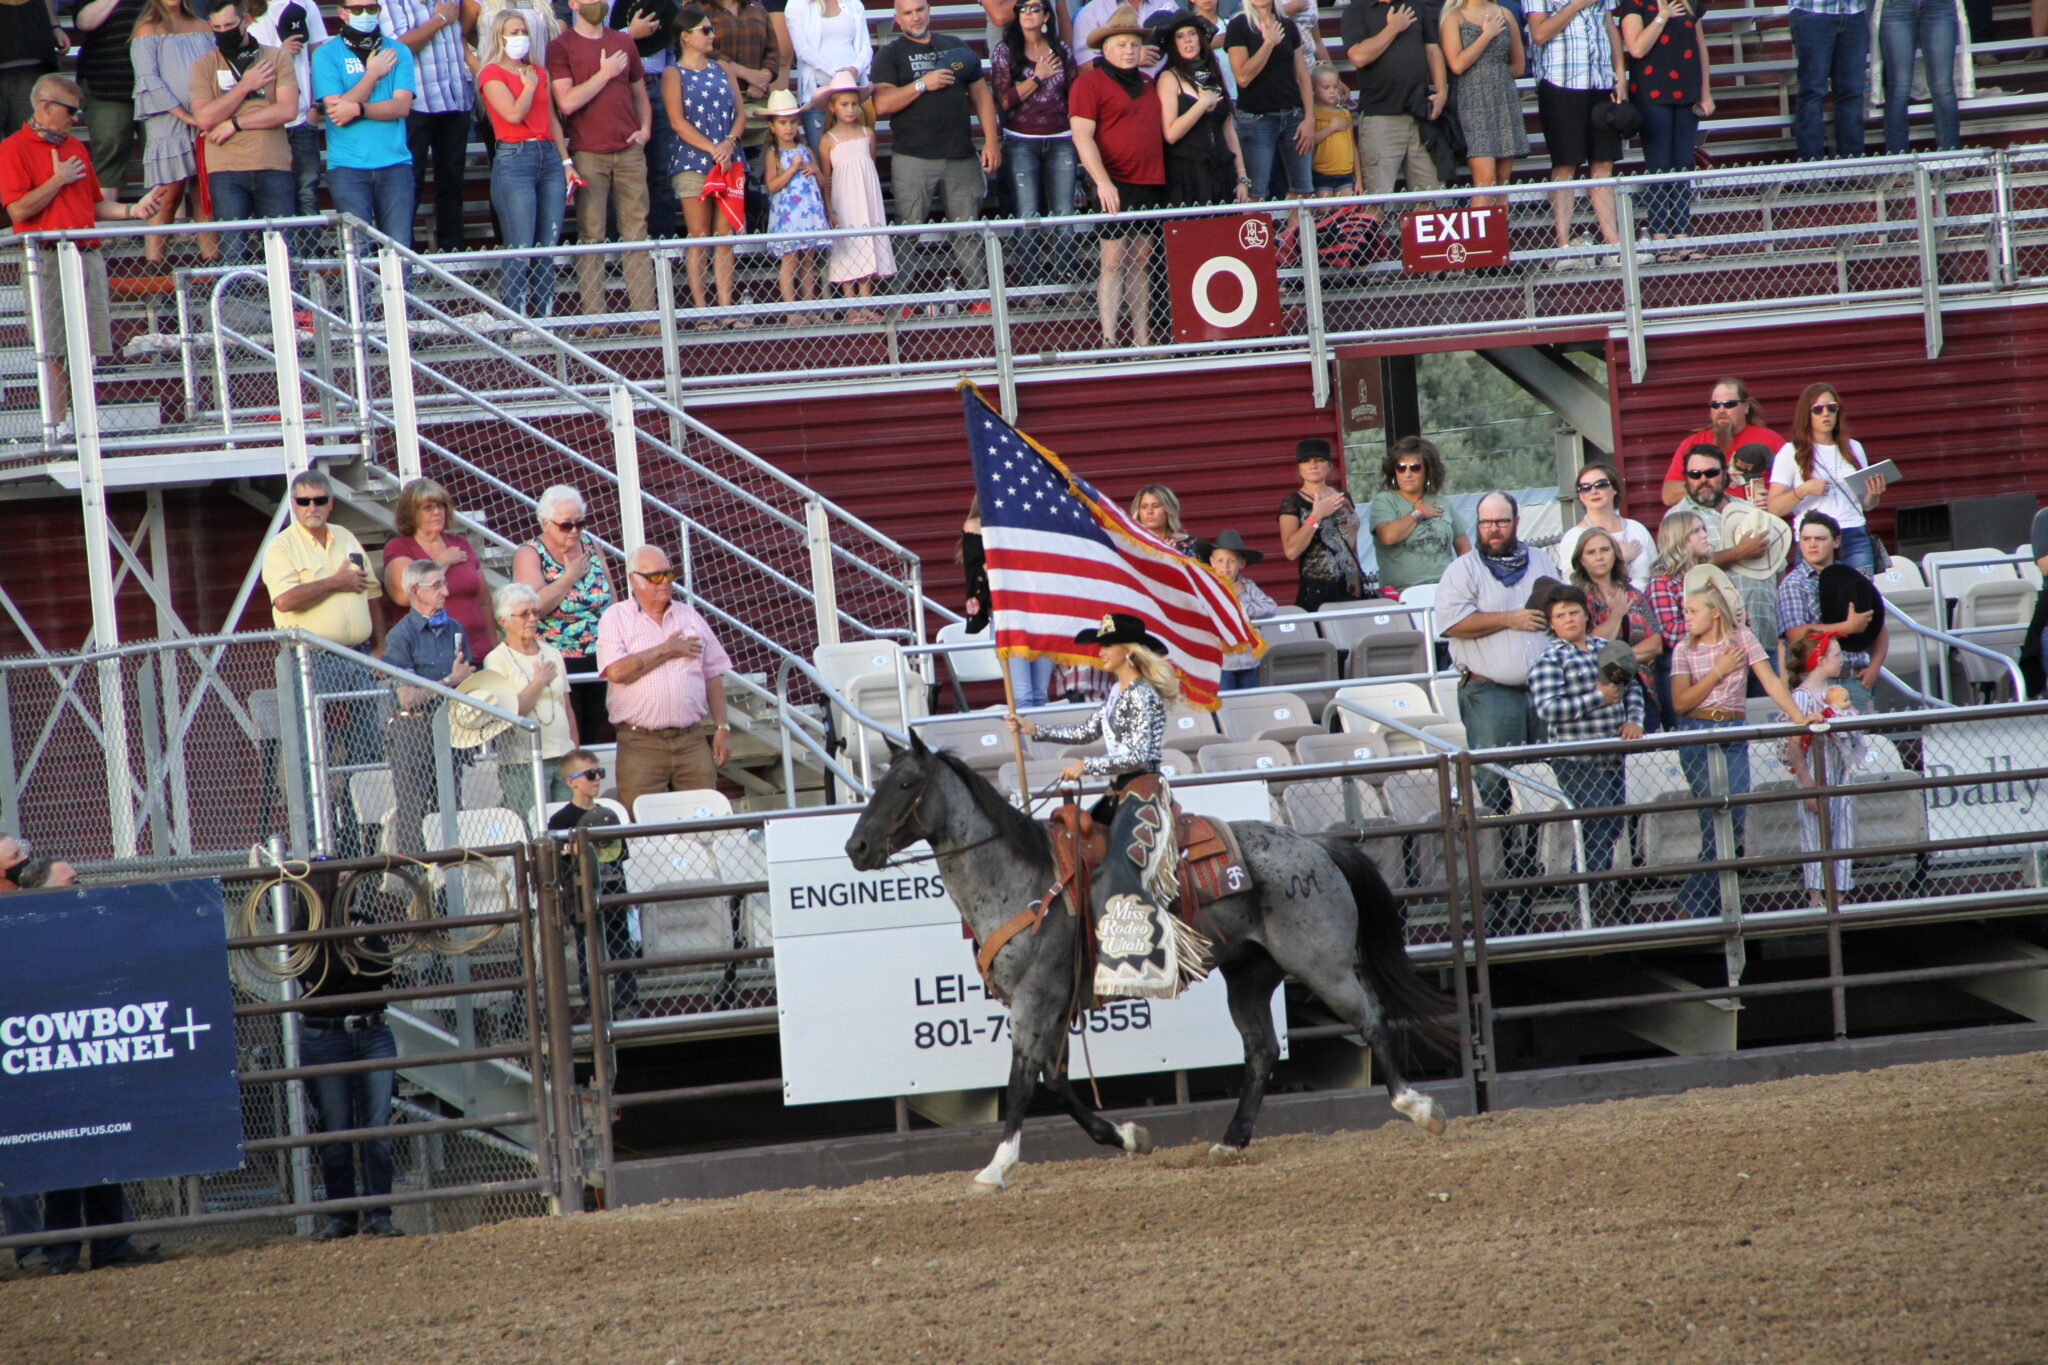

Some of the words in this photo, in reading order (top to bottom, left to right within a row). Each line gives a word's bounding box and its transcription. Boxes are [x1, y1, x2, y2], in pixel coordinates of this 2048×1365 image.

[1415, 210, 1491, 243] EXIT
[1192, 255, 1258, 328] O
[790, 875, 945, 910] ENGINEERS
[1112, 900, 1145, 920] Miss
[1102, 919, 1149, 937] Rodeo
[1108, 936, 1146, 953] Utah
[915, 974, 994, 1006] LEI-
[0, 1001, 168, 1046] COWBOY
[2, 1033, 174, 1075] CHANNEL
